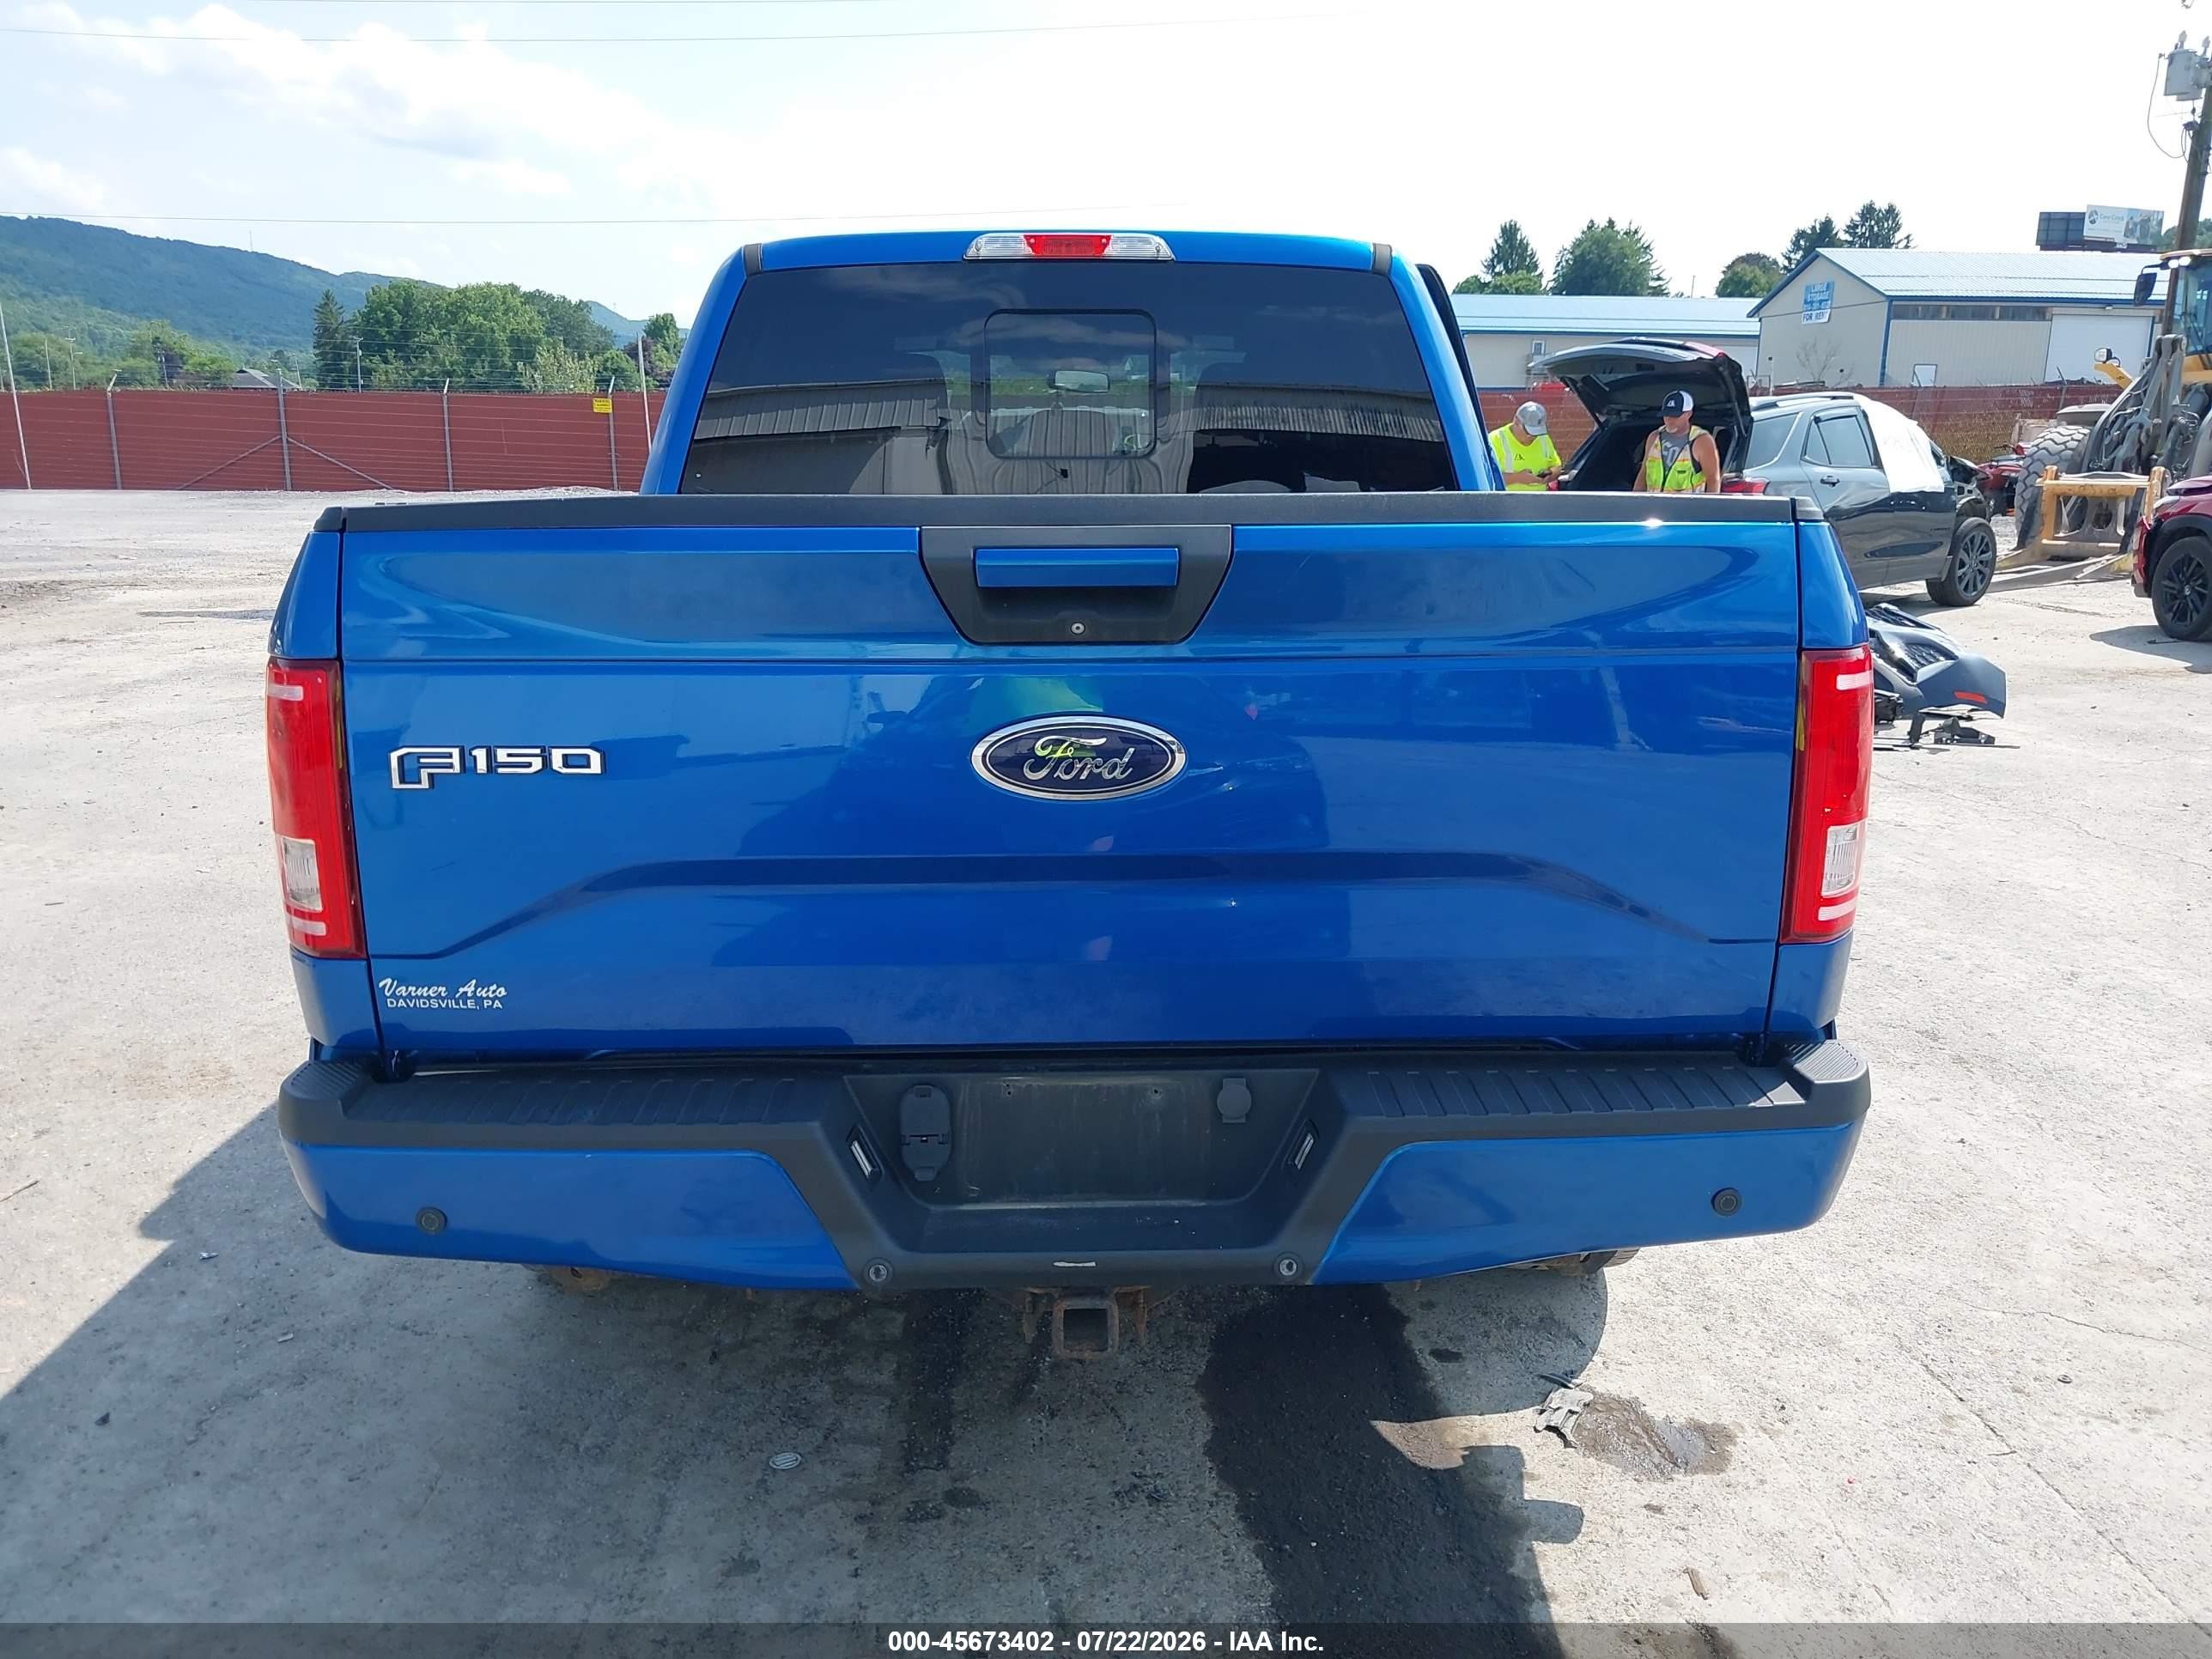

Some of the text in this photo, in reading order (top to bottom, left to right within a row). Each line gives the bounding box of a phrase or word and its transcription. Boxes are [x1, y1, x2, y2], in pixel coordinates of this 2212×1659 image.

[1802, 311, 1828, 323] FOR RENT
[1023, 735, 1136, 781] Ford
[378, 976, 507, 998] Varner Auto
[386, 998, 504, 1011] DAVIDSVILLE, PA
